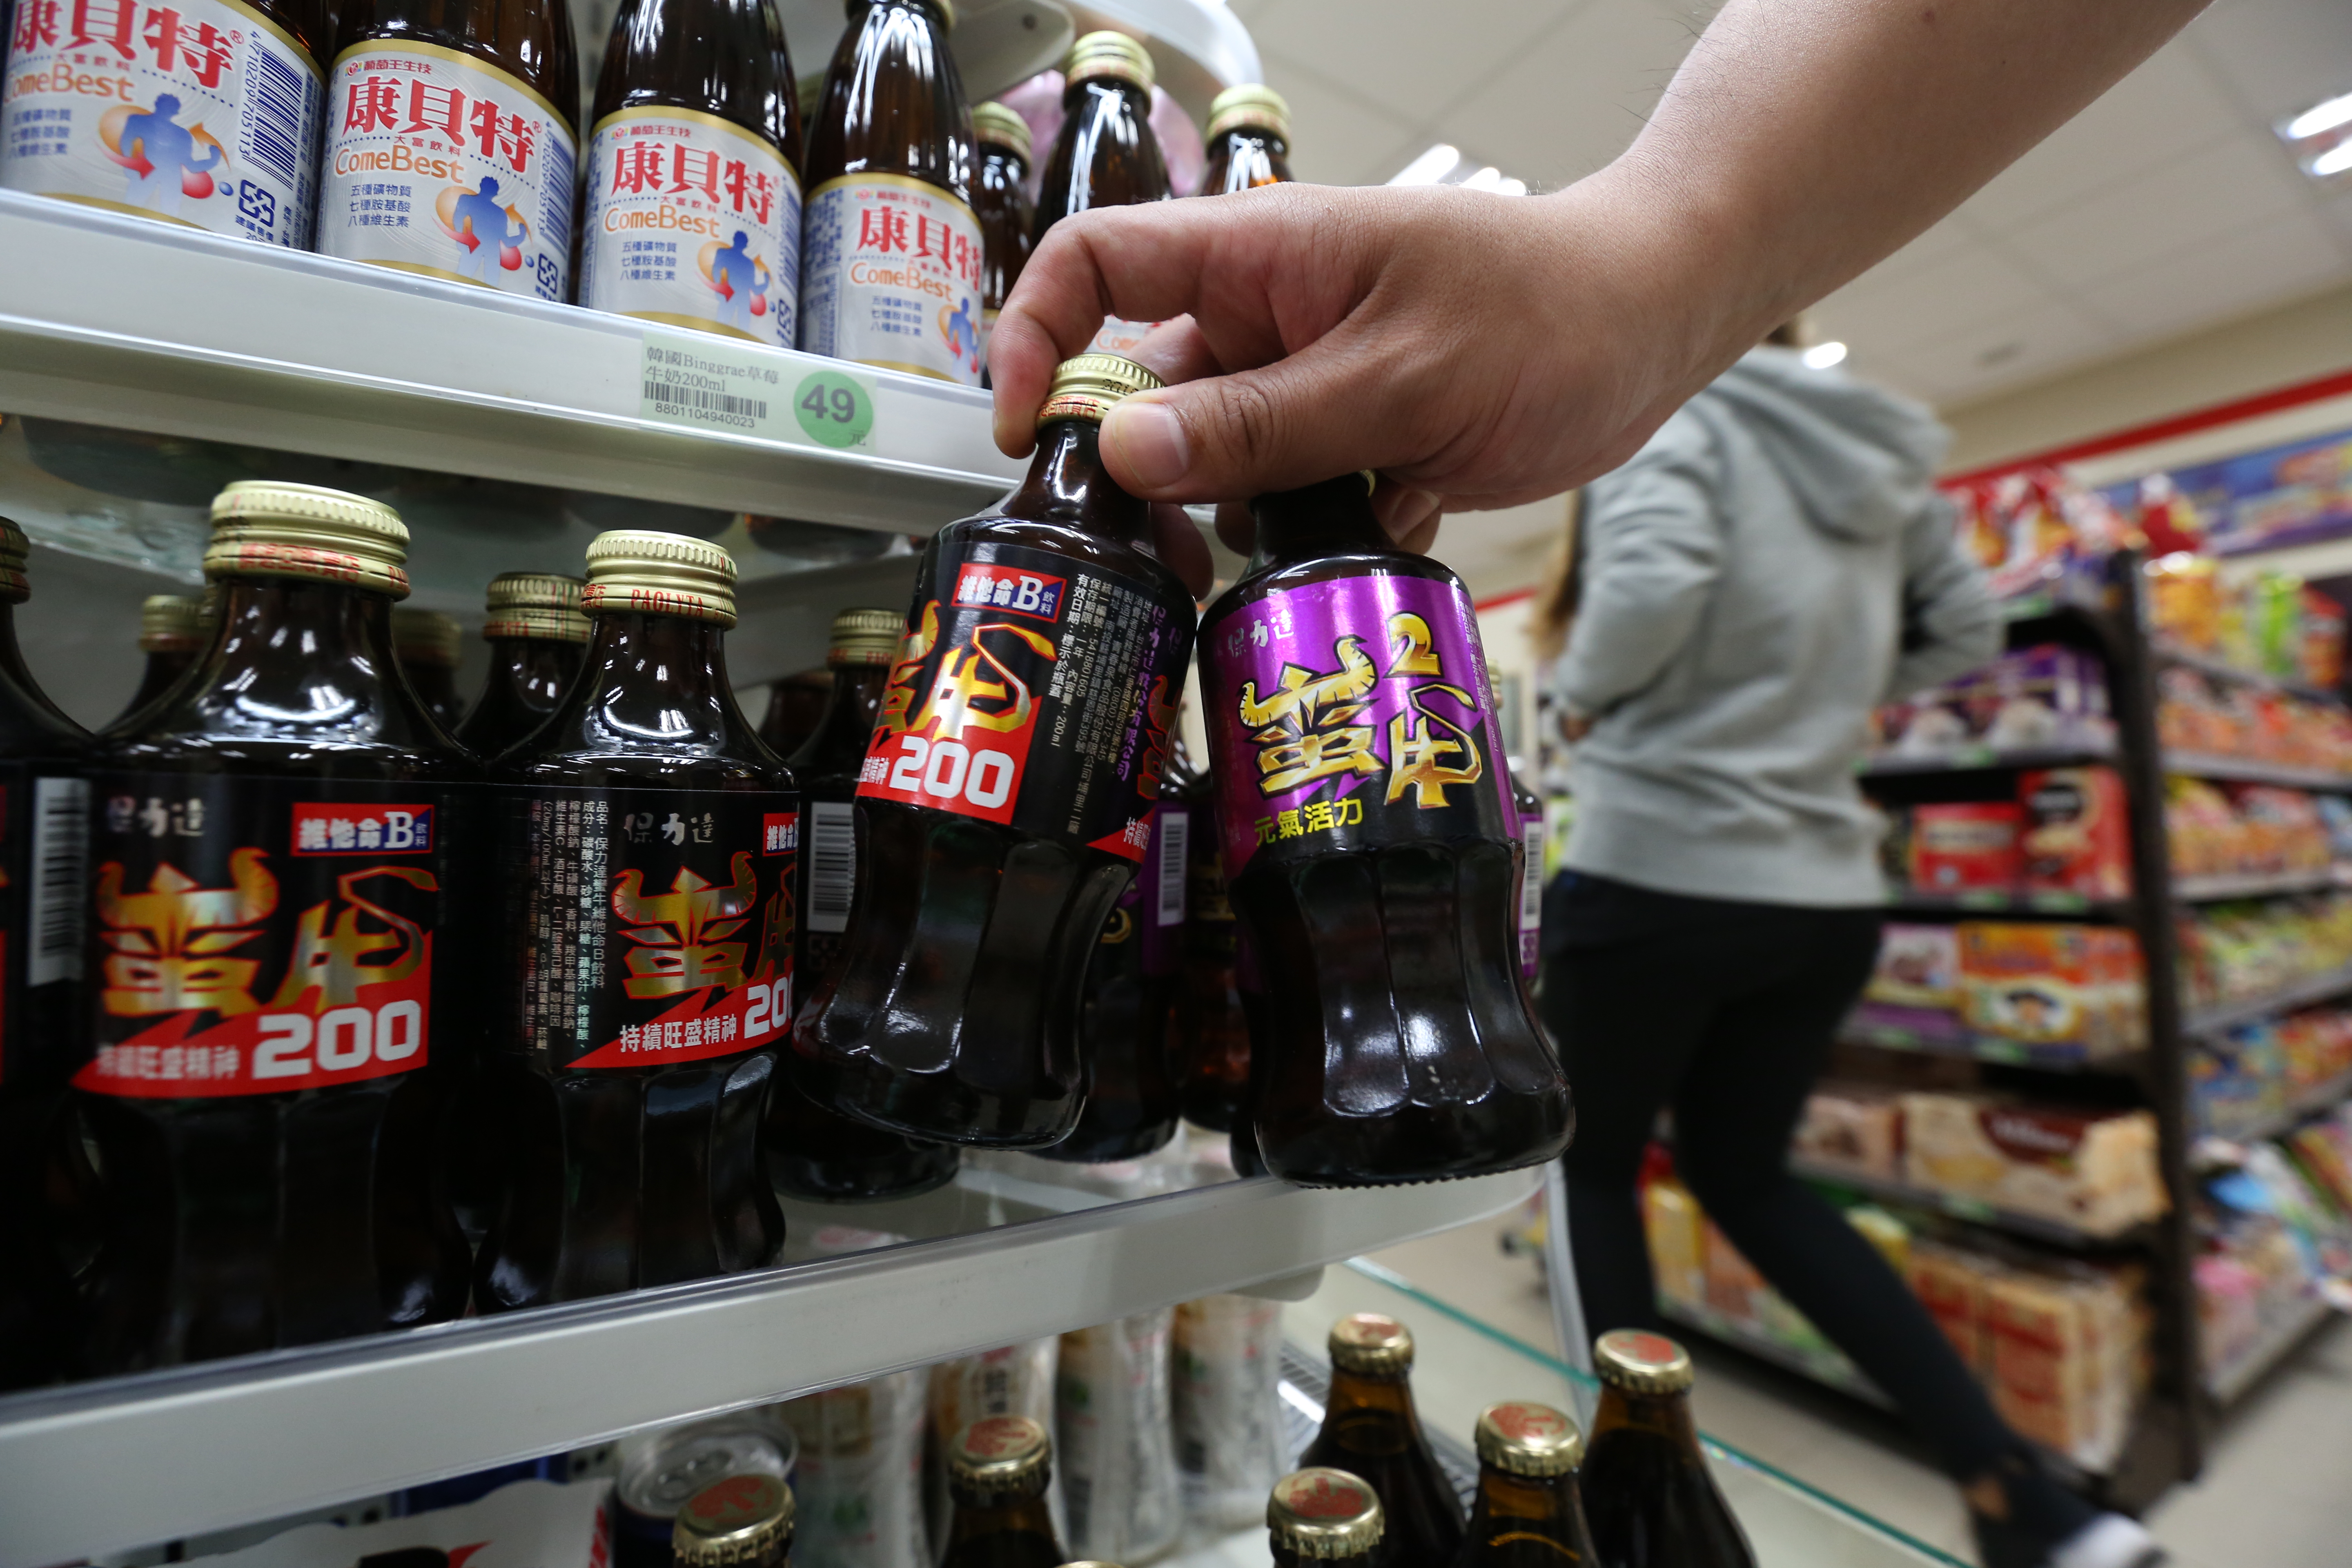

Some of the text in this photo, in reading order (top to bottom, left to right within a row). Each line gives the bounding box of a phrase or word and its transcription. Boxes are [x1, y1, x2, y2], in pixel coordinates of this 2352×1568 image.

[11, 0, 234, 89] 康貝特
[3, 63, 134, 102] ComeBest
[364, 59, 432, 75] 葡萄王生技
[341, 76, 534, 173] 康貝特
[630, 125, 692, 139] 葡萄王生技
[335, 145, 464, 184] ComeBest
[394, 135, 461, 156] 大富飲料
[350, 184, 412, 198] 五種礦物質
[610, 140, 776, 225] 康貝特
[347, 214, 410, 228] 八種維生素
[349, 199, 411, 213] 七種胺基酸
[604, 205, 721, 238] ComeBest
[621, 240, 677, 254] 五種礦物質
[621, 255, 677, 268] 七種胺基酸
[855, 205, 981, 291] 康貝特
[619, 269, 676, 281] 八種維生素
[851, 261, 954, 302] ComeBest
[645, 366, 726, 392] 牛奶200ml
[647, 346, 780, 385] 韓國Binggrae草莓
[655, 402, 755, 428] 8801104940023
[801, 383, 855, 423] 49
[849, 429, 866, 446] 元
[630, 589, 704, 617] PAOLYTA
[958, 575, 1056, 616] 維他命B 飲料
[1228, 611, 1294, 658] 保力達
[1385, 611, 1445, 678] 2
[889, 735, 1016, 810] 200
[298, 810, 427, 850] 維他命B 飲料
[623, 812, 714, 846] 保力達
[1254, 798, 1364, 848] 元氣活力
[252, 999, 422, 1080] 200
[619, 1013, 737, 1054] 持續旺盛精神
